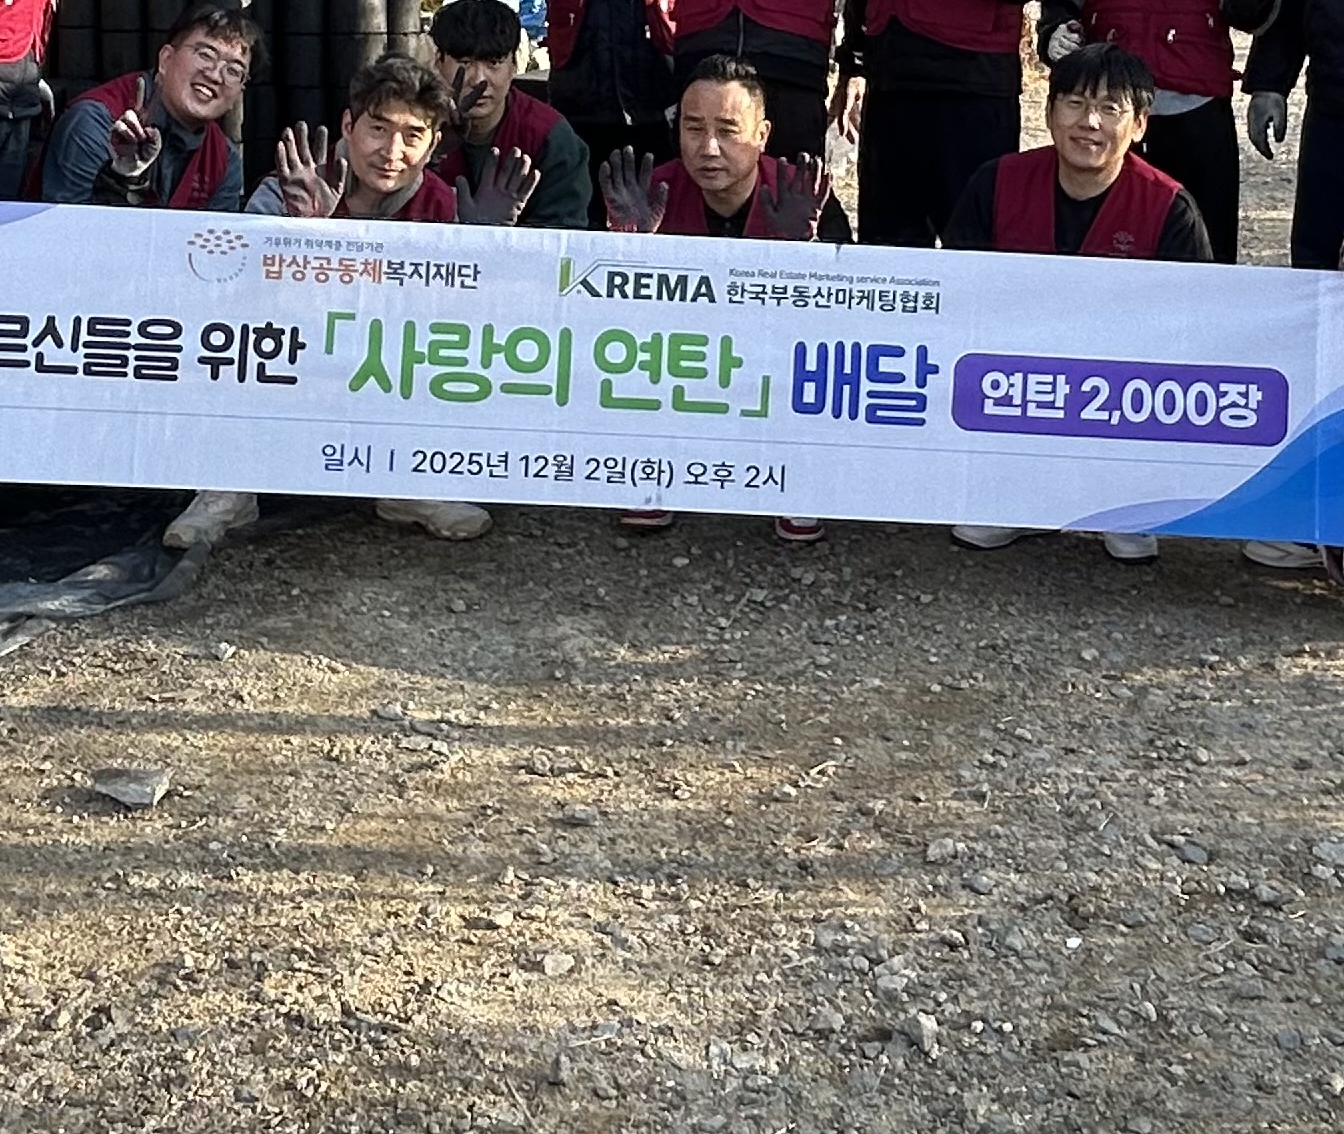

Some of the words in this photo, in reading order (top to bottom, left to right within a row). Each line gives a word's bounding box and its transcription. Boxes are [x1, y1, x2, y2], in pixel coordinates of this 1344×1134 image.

[262, 253, 482, 290] 밥상공동체복지재단
[559, 257, 717, 304] KREMA
[729, 268, 756, 278] Korea
[757, 269, 778, 279] Real
[809, 271, 854, 285] Marketing
[890, 276, 941, 287] Association
[726, 281, 941, 314] 한국부동산마케팅협회
[197, 321, 308, 385] 위한
[791, 339, 941, 427] 배달
[980, 370, 1070, 420] 연탄
[1079, 374, 1263, 429] 2,000장
[321, 443, 372, 474] 일시
[411, 449, 510, 480] 2025년
[518, 453, 575, 483] 12월
[585, 456, 675, 489] 2일(화)
[683, 460, 737, 490] 오후
[743, 463, 787, 493] 2시
